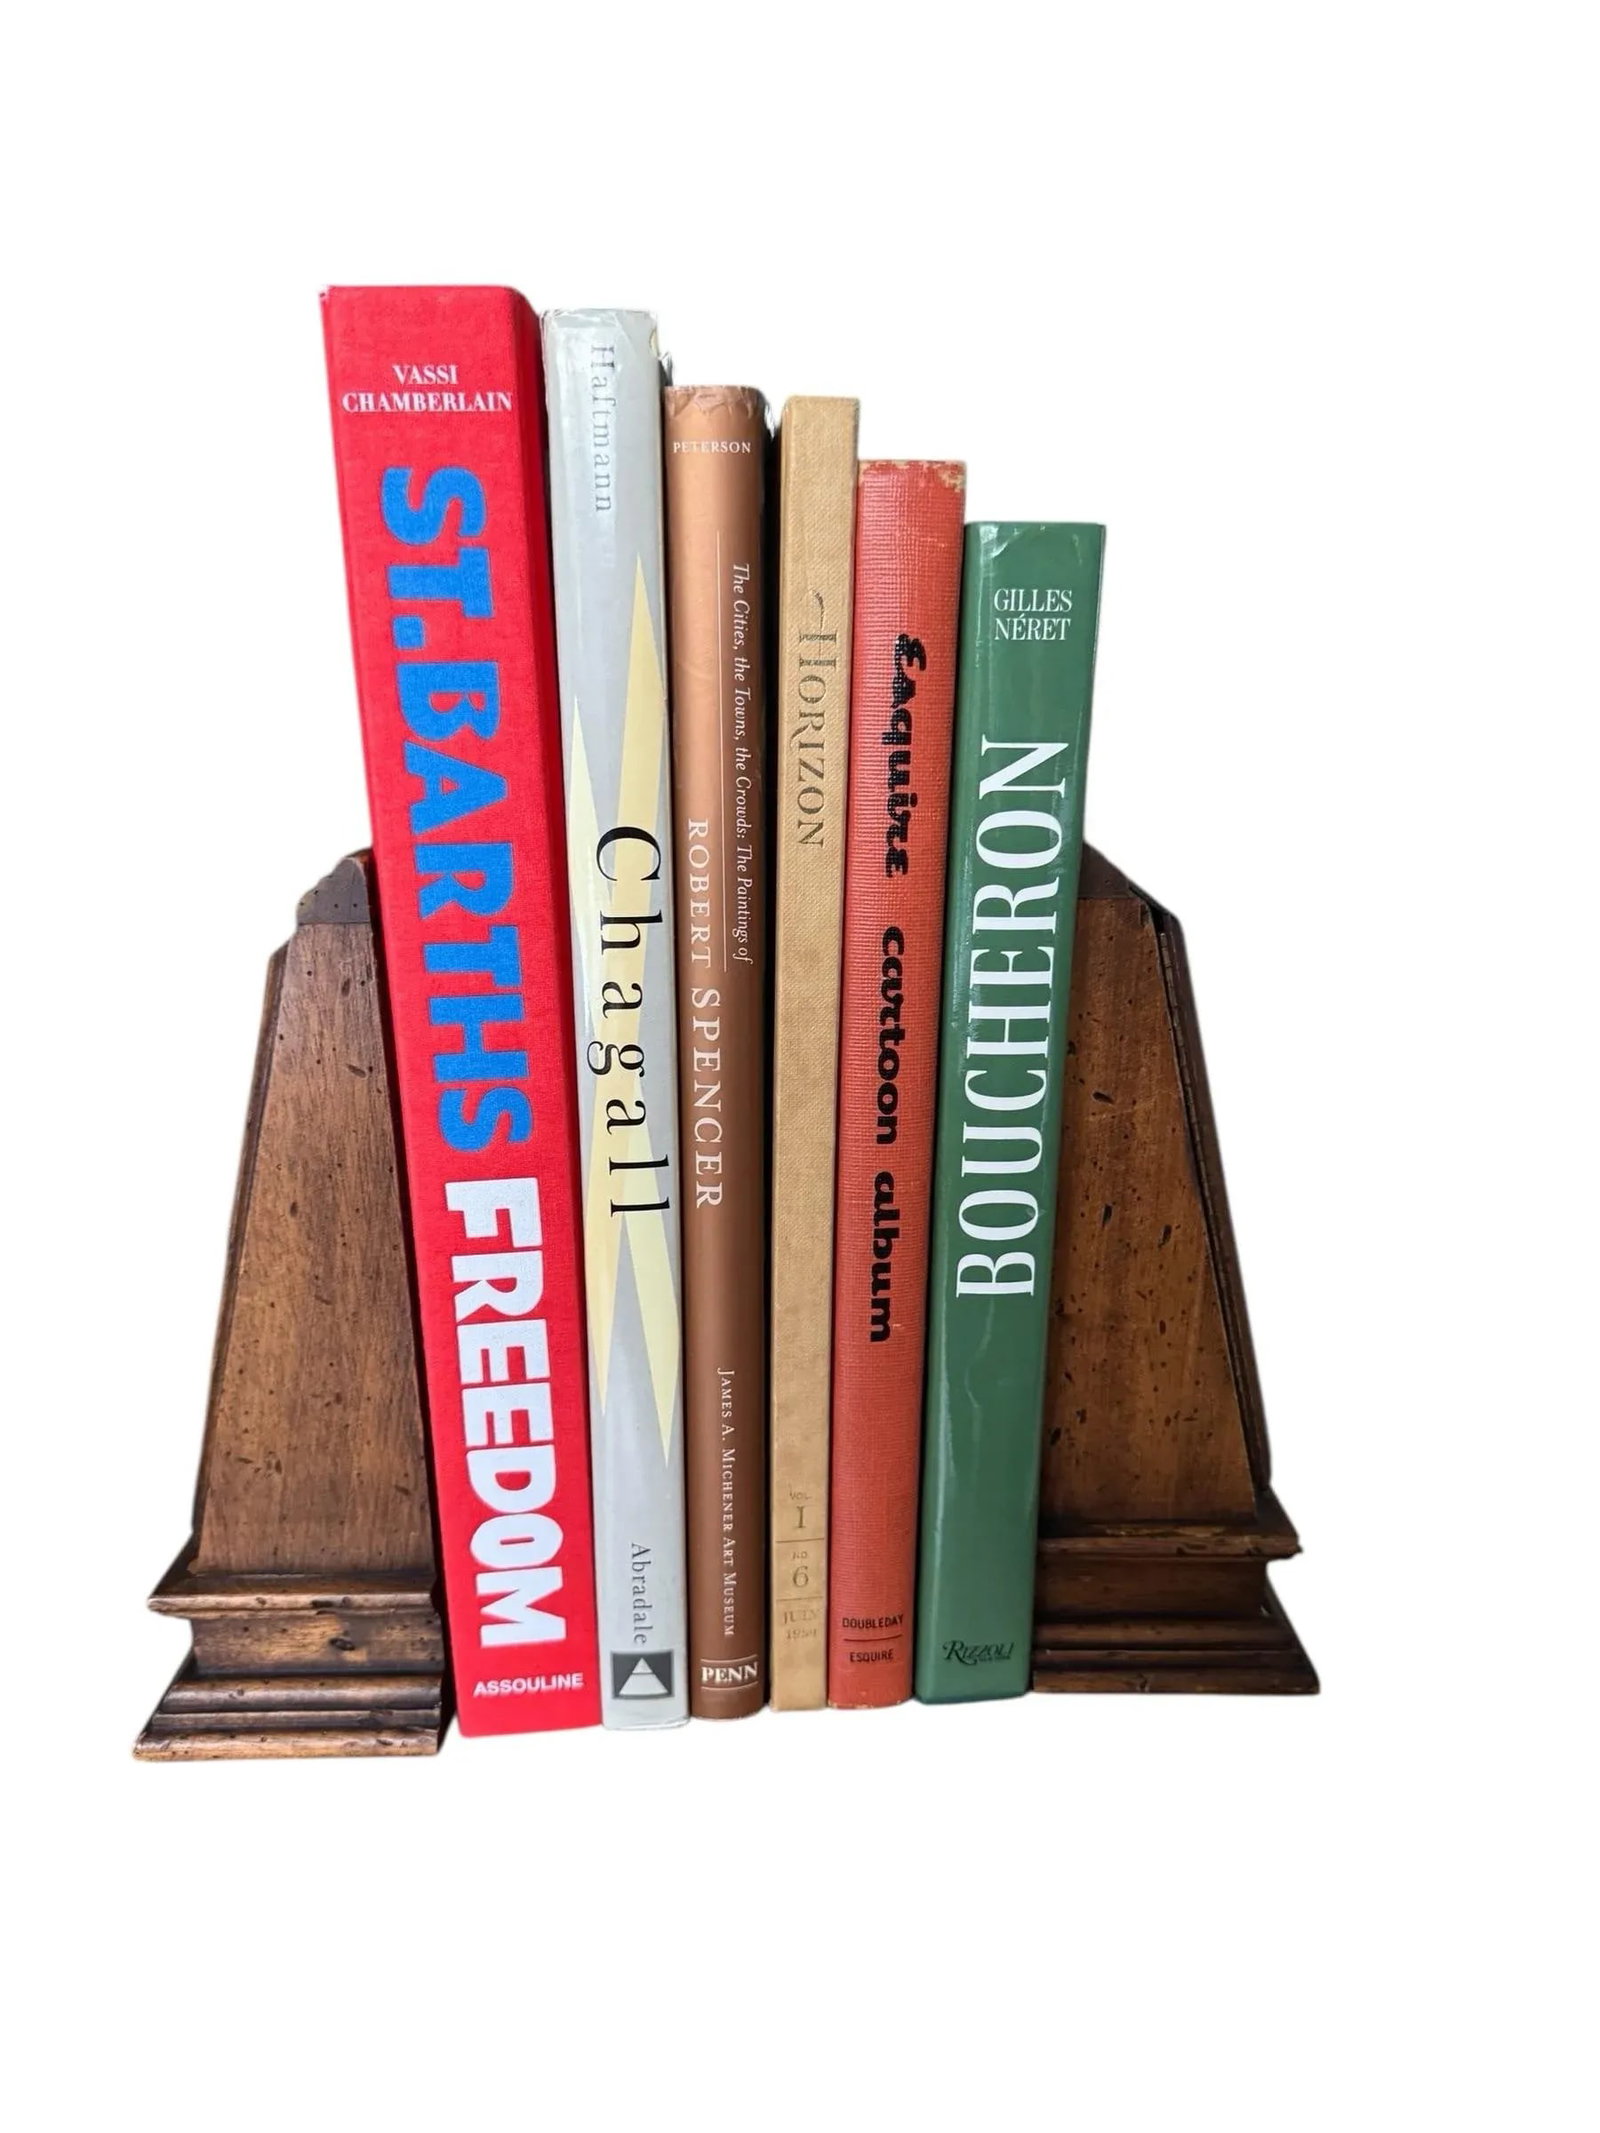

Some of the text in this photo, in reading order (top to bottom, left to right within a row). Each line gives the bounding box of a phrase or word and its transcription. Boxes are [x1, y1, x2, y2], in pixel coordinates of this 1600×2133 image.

[392, 364, 459, 386] VASSI
[342, 391, 513, 414] CHAMBERLAIN
[590, 345, 616, 513] Haftmann
[673, 441, 752, 454] PETERSON
[994, 587, 1073, 613] GILLES
[994, 612, 1071, 641] NÉRET
[789, 588, 838, 849] HORIZON
[732, 563, 754, 965] The Cities, the Towns, the Crowds: The Paintings of
[870, 633, 927, 1343] Esquire cartoon album
[586, 826, 671, 1218] Chagall
[688, 818, 724, 1210] ROBERT SPENCER
[956, 733, 1070, 1298] BOUCHERON
[445, 1177, 567, 1649] FREEDOM
[721, 1424, 736, 1442] A.
[722, 1447, 736, 1532] MICHENER
[722, 1537, 737, 1567] ART
[792, 1565, 809, 1588] 6
[631, 1542, 655, 1645] Abradale
[723, 1572, 737, 1637] MUSEUM
[842, 1614, 904, 1628] DOUBLEDAY
[850, 1649, 894, 1663] ESQUIRE
[473, 1672, 584, 1697] ASSOULINE
[701, 1661, 759, 1683] PENN
